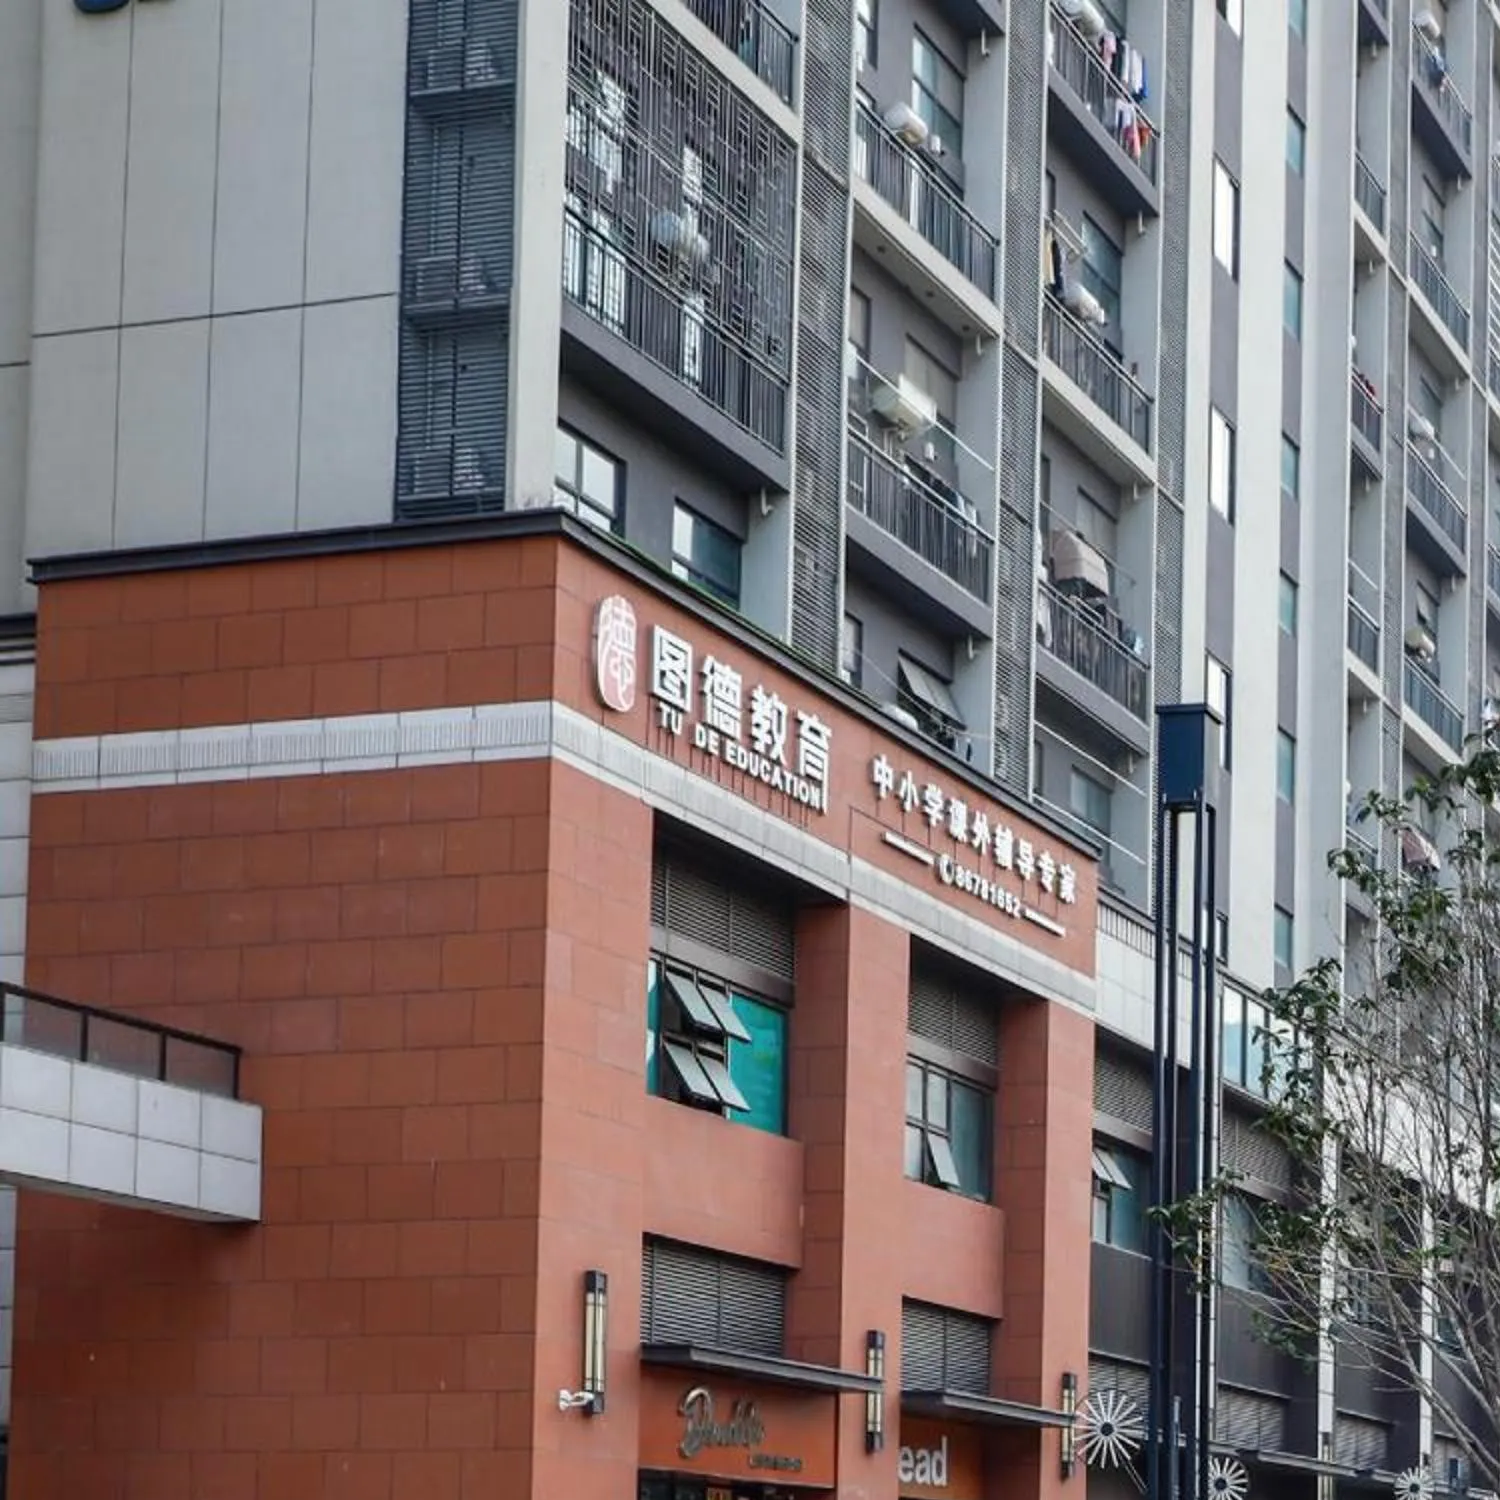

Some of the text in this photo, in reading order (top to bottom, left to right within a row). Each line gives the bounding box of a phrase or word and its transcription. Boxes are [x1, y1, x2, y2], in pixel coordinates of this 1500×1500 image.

[653, 624, 833, 815] 图德教育
[658, 701, 821, 810] TU DE EDUCATION
[873, 753, 1076, 904] 中小学课外辅导专家
